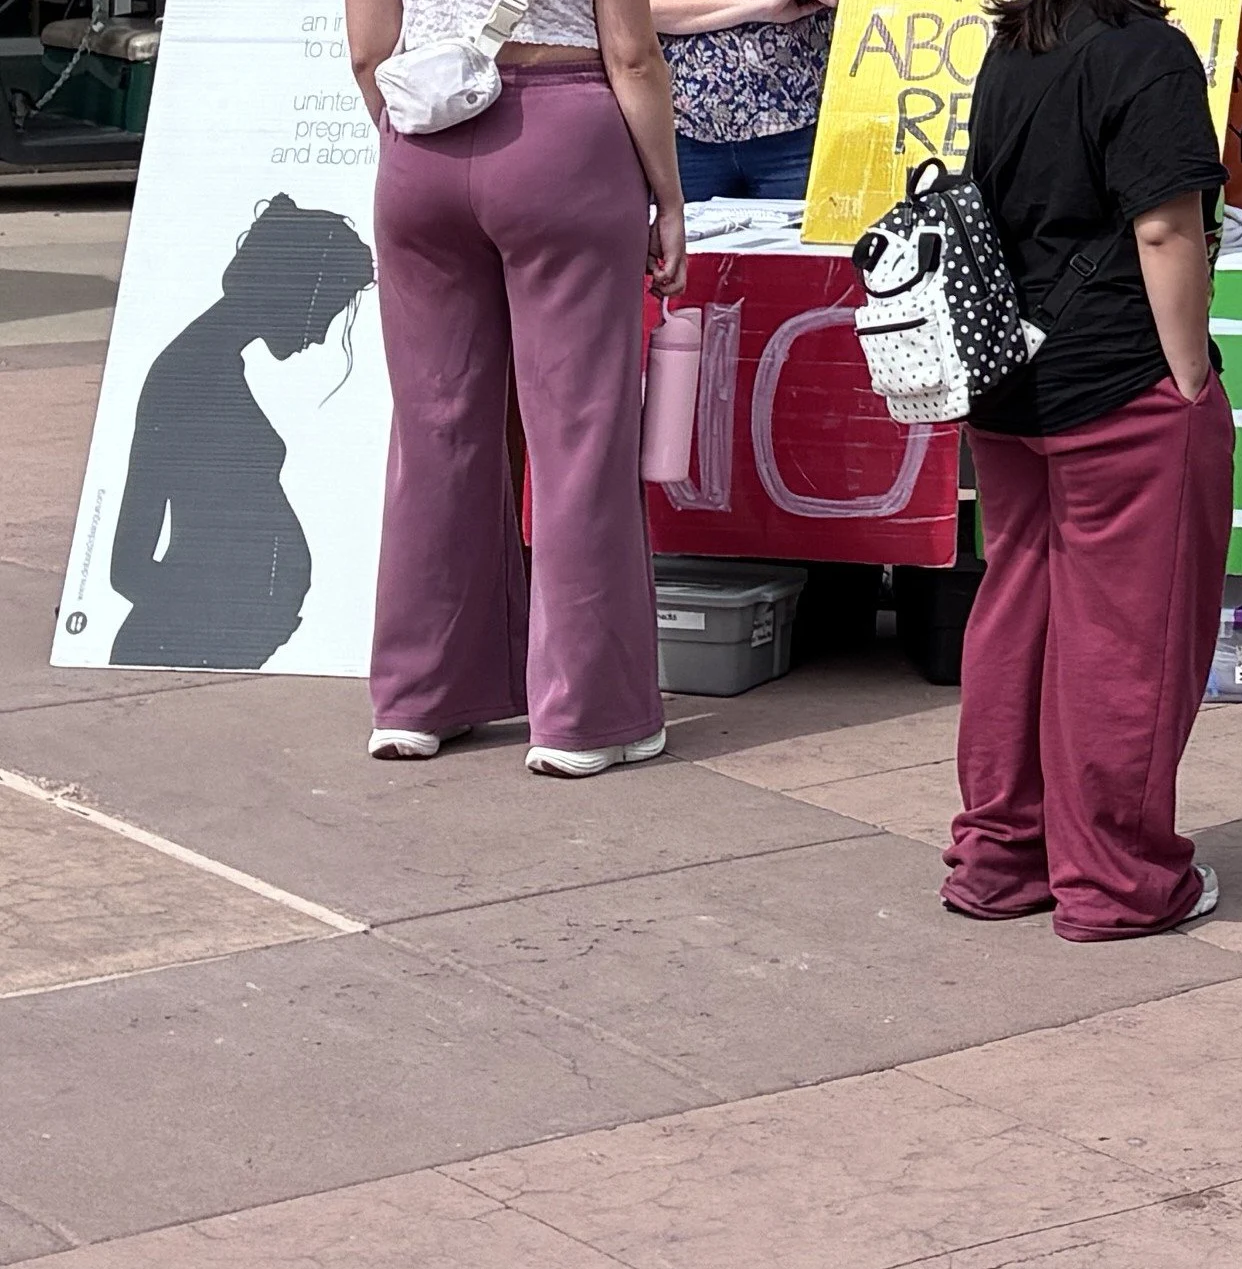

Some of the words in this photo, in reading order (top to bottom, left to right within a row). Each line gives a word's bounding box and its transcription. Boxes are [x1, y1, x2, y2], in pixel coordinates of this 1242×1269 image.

[301, 15, 327, 32] an
[304, 39, 322, 58] to
[270, 143, 311, 164] and
